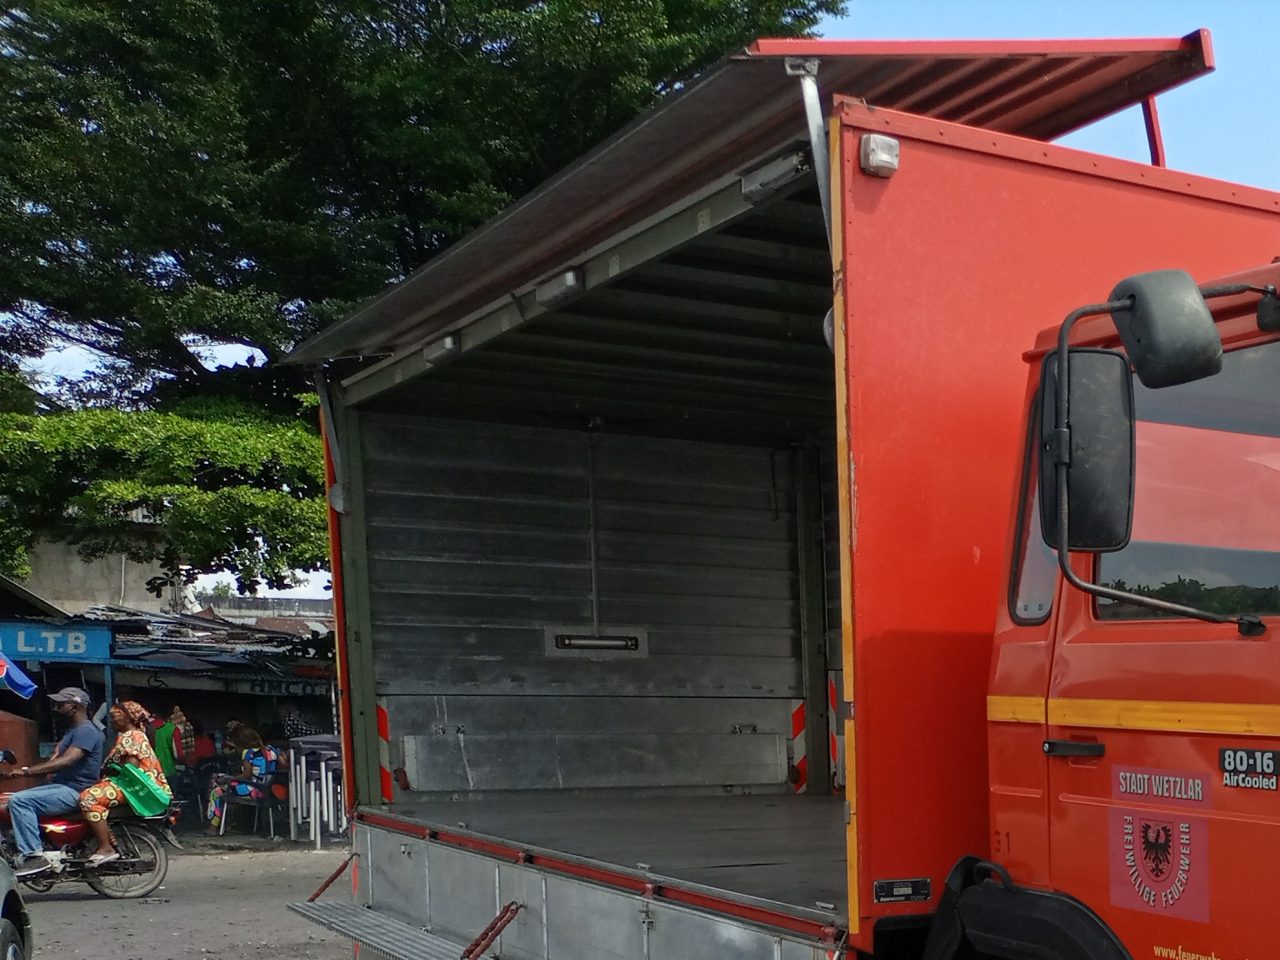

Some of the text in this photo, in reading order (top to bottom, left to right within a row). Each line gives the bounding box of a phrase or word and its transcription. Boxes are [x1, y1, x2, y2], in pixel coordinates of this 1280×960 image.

[17, 630, 87, 654] L.T.B
[1119, 771, 1203, 801] STADT WETZLAR
[1222, 772, 1278, 791] AirCooled
[1123, 815, 1191, 907] FREIWILLIGE FEUERWEHR
